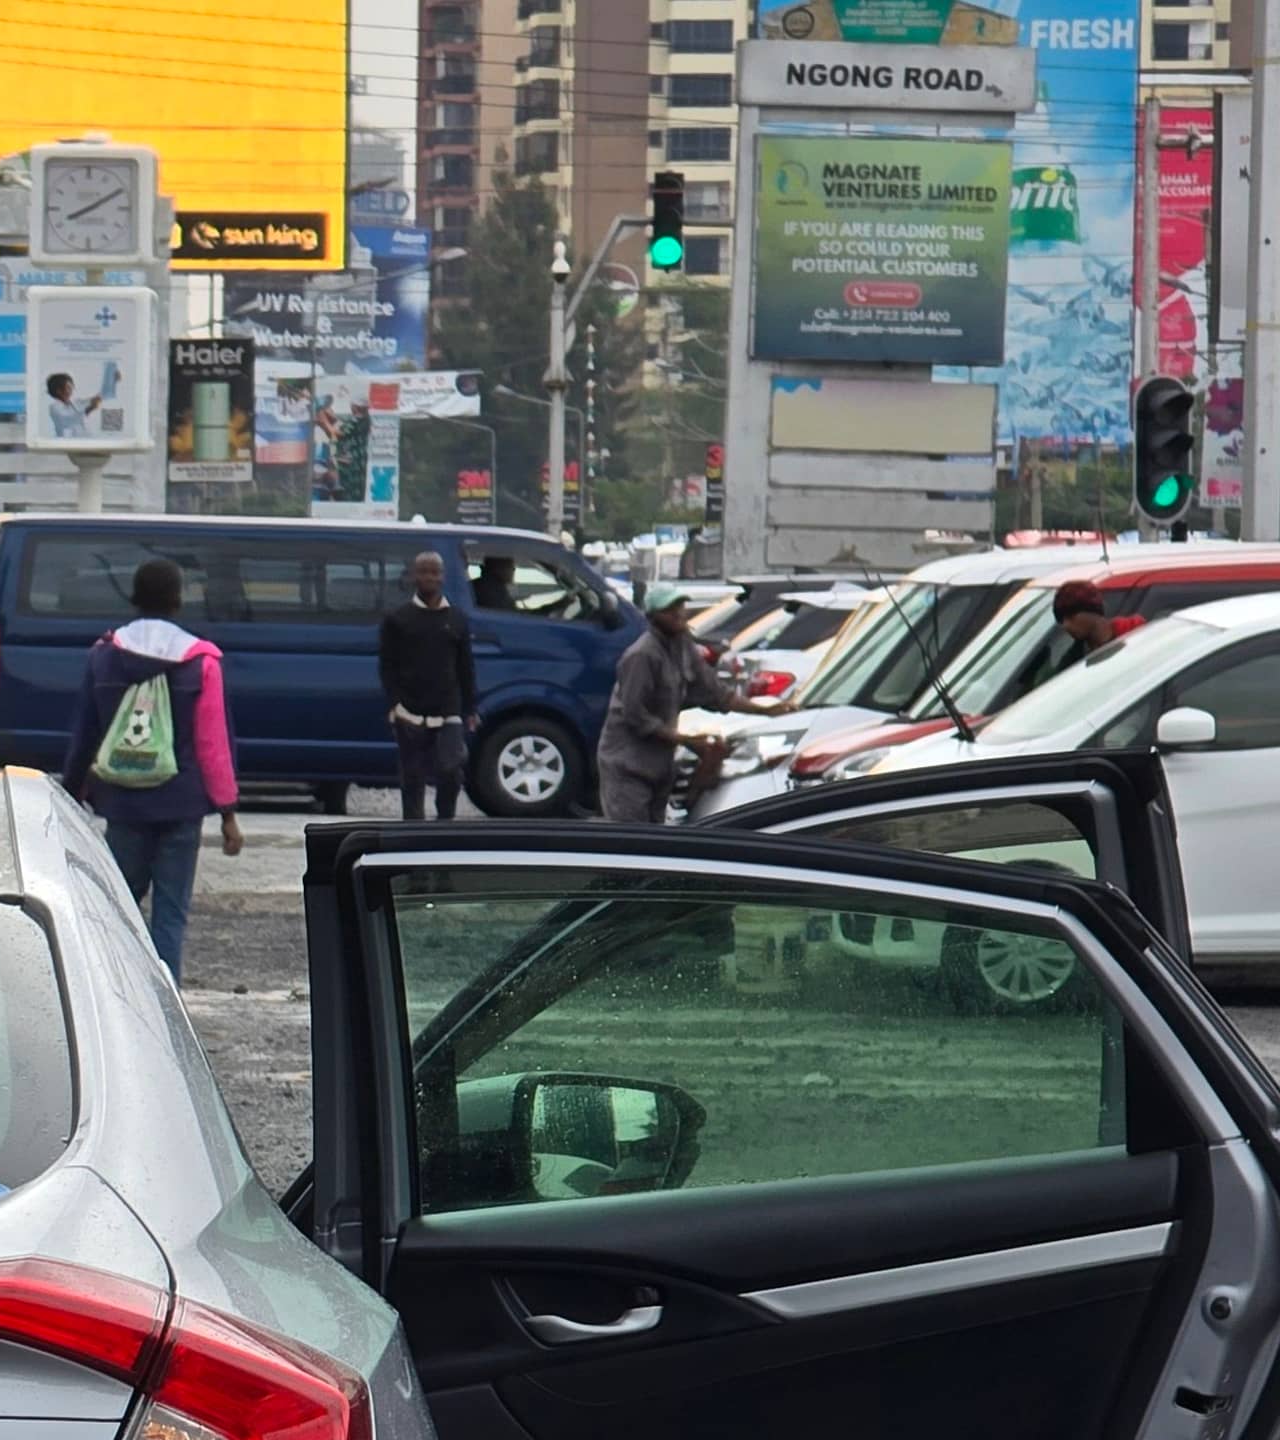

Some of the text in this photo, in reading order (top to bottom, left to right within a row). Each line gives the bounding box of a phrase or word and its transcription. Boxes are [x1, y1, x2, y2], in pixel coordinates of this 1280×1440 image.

[1030, 18, 1134, 50] FRESH
[786, 62, 984, 93] NGONG ROAD
[822, 163, 922, 181] MAGNATE
[822, 182, 998, 202] VENTURES LIMITED
[222, 223, 318, 251] sun king
[784, 221, 985, 241] IF YOU ARE READING THIS
[818, 240, 951, 258] SO COULD YOUR
[792, 258, 978, 278] POTENTIAL CUSTOMERS
[256, 292, 395, 317] UV Reistance
[316, 315, 333, 334] &
[175, 342, 245, 365] Haier
